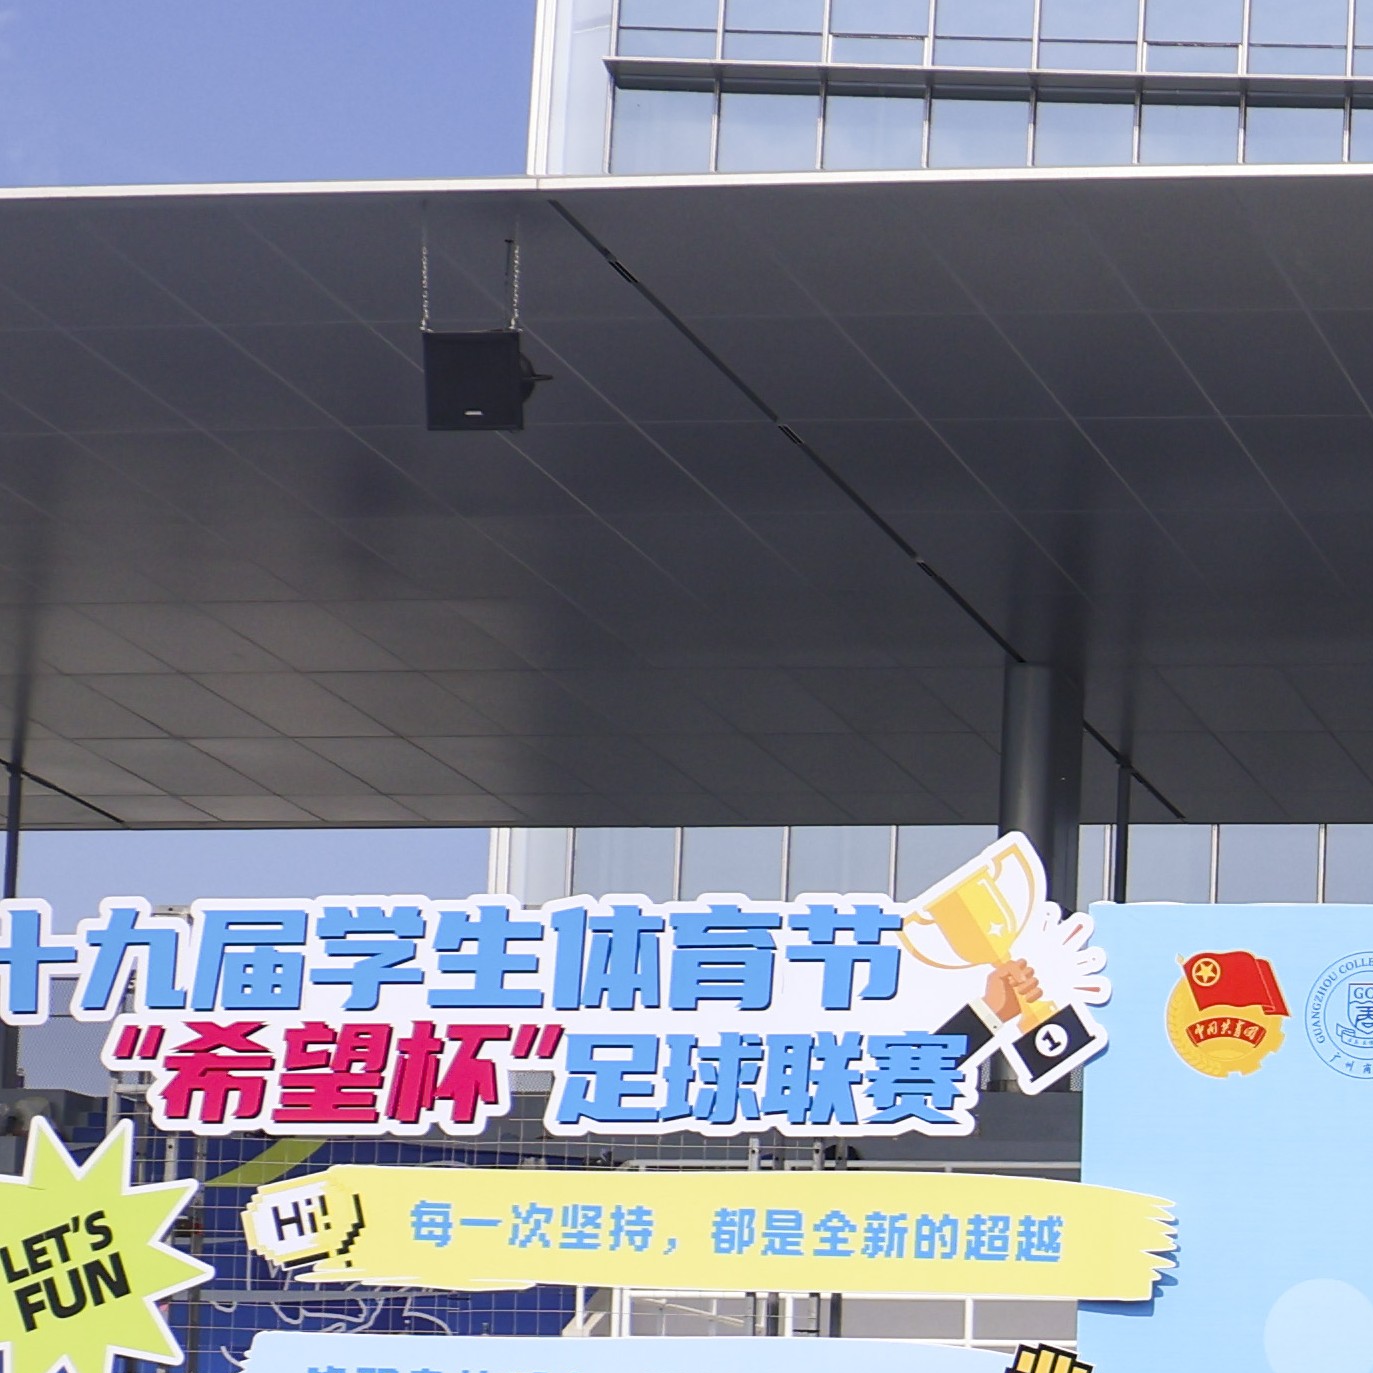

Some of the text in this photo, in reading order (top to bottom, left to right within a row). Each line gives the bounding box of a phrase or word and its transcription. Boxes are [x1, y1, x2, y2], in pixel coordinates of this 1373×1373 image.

[0, 904, 902, 1014] 十九届学生体育节
[1042, 1030, 1061, 1051] 1
[1311, 971, 1338, 1044] GUANGZHOU
[271, 1194, 332, 1242] Hi!
[13, 1251, 132, 1333] FUN
